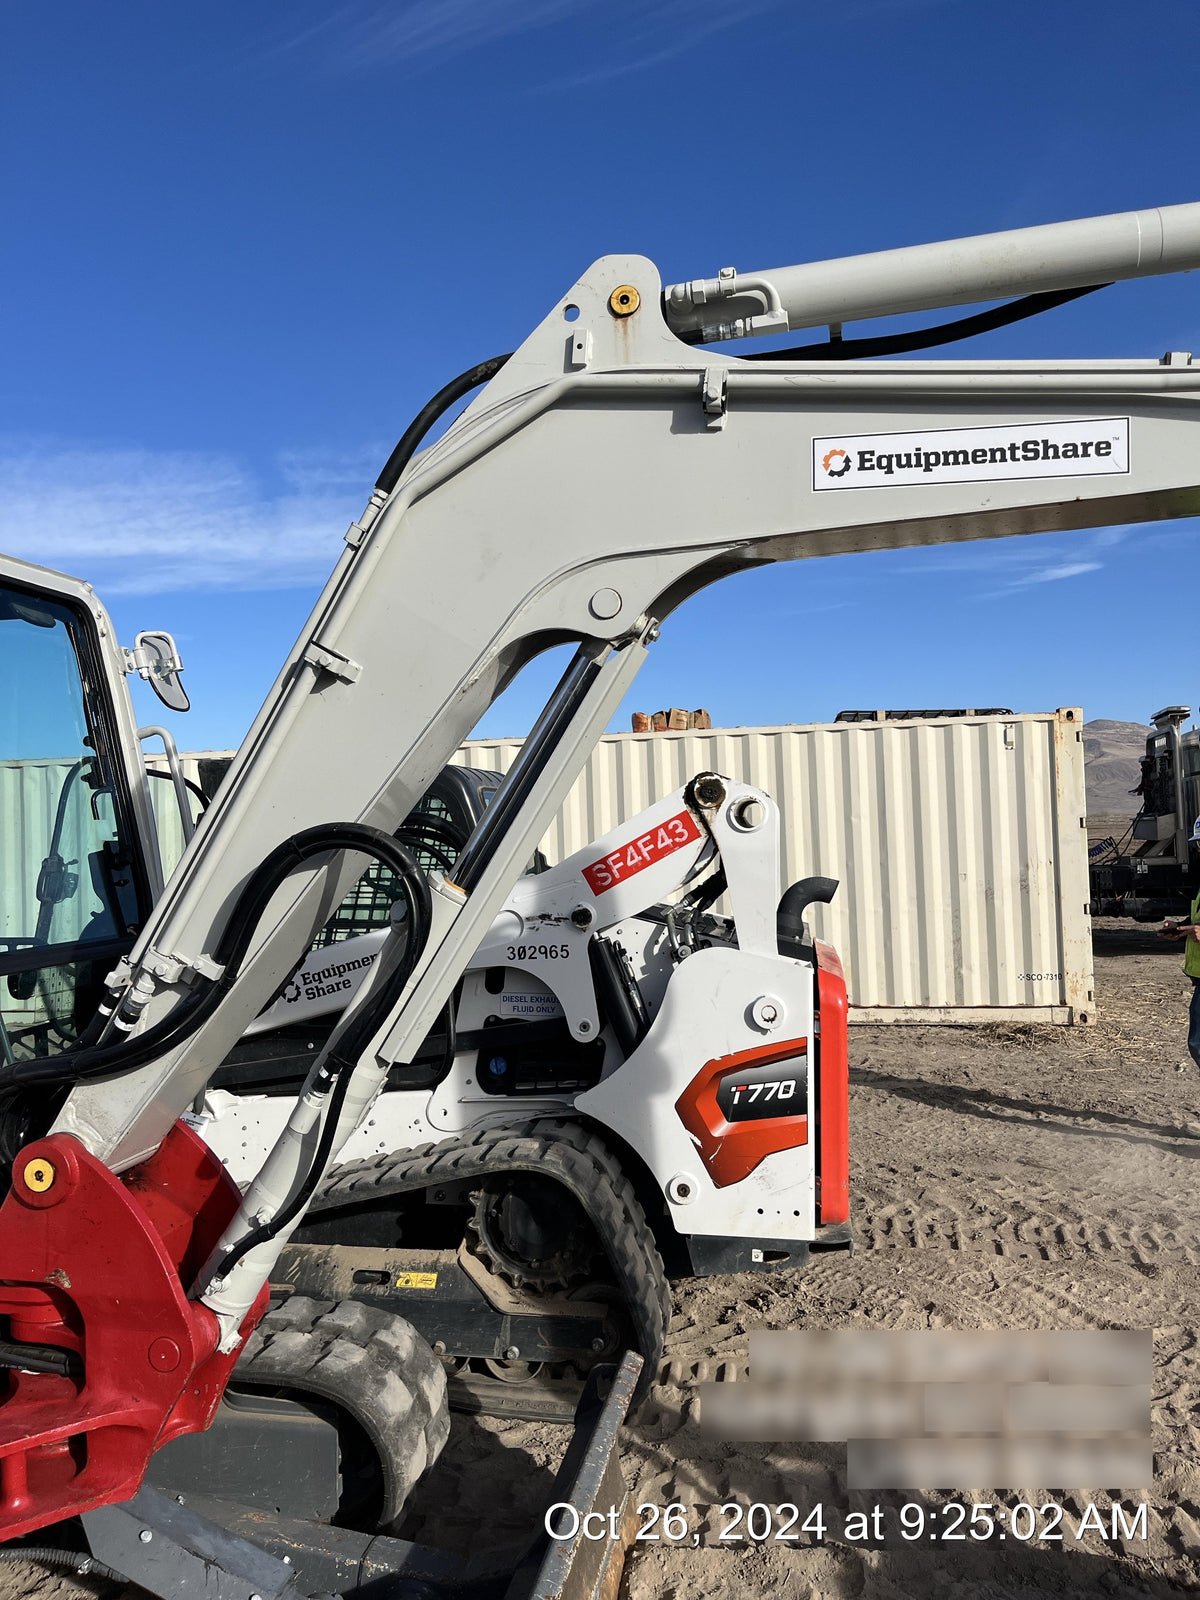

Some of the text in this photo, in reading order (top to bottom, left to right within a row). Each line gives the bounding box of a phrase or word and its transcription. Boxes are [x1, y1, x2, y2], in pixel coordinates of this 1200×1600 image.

[857, 439, 1112, 475] EquipmentShare
[591, 819, 689, 887] SF4F43
[506, 944, 570, 960] 302965
[304, 978, 352, 1001] Share
[502, 995, 529, 1003] DIESEL
[512, 1005, 556, 1013] FLUID ONLY
[730, 1079, 797, 1105] T770
